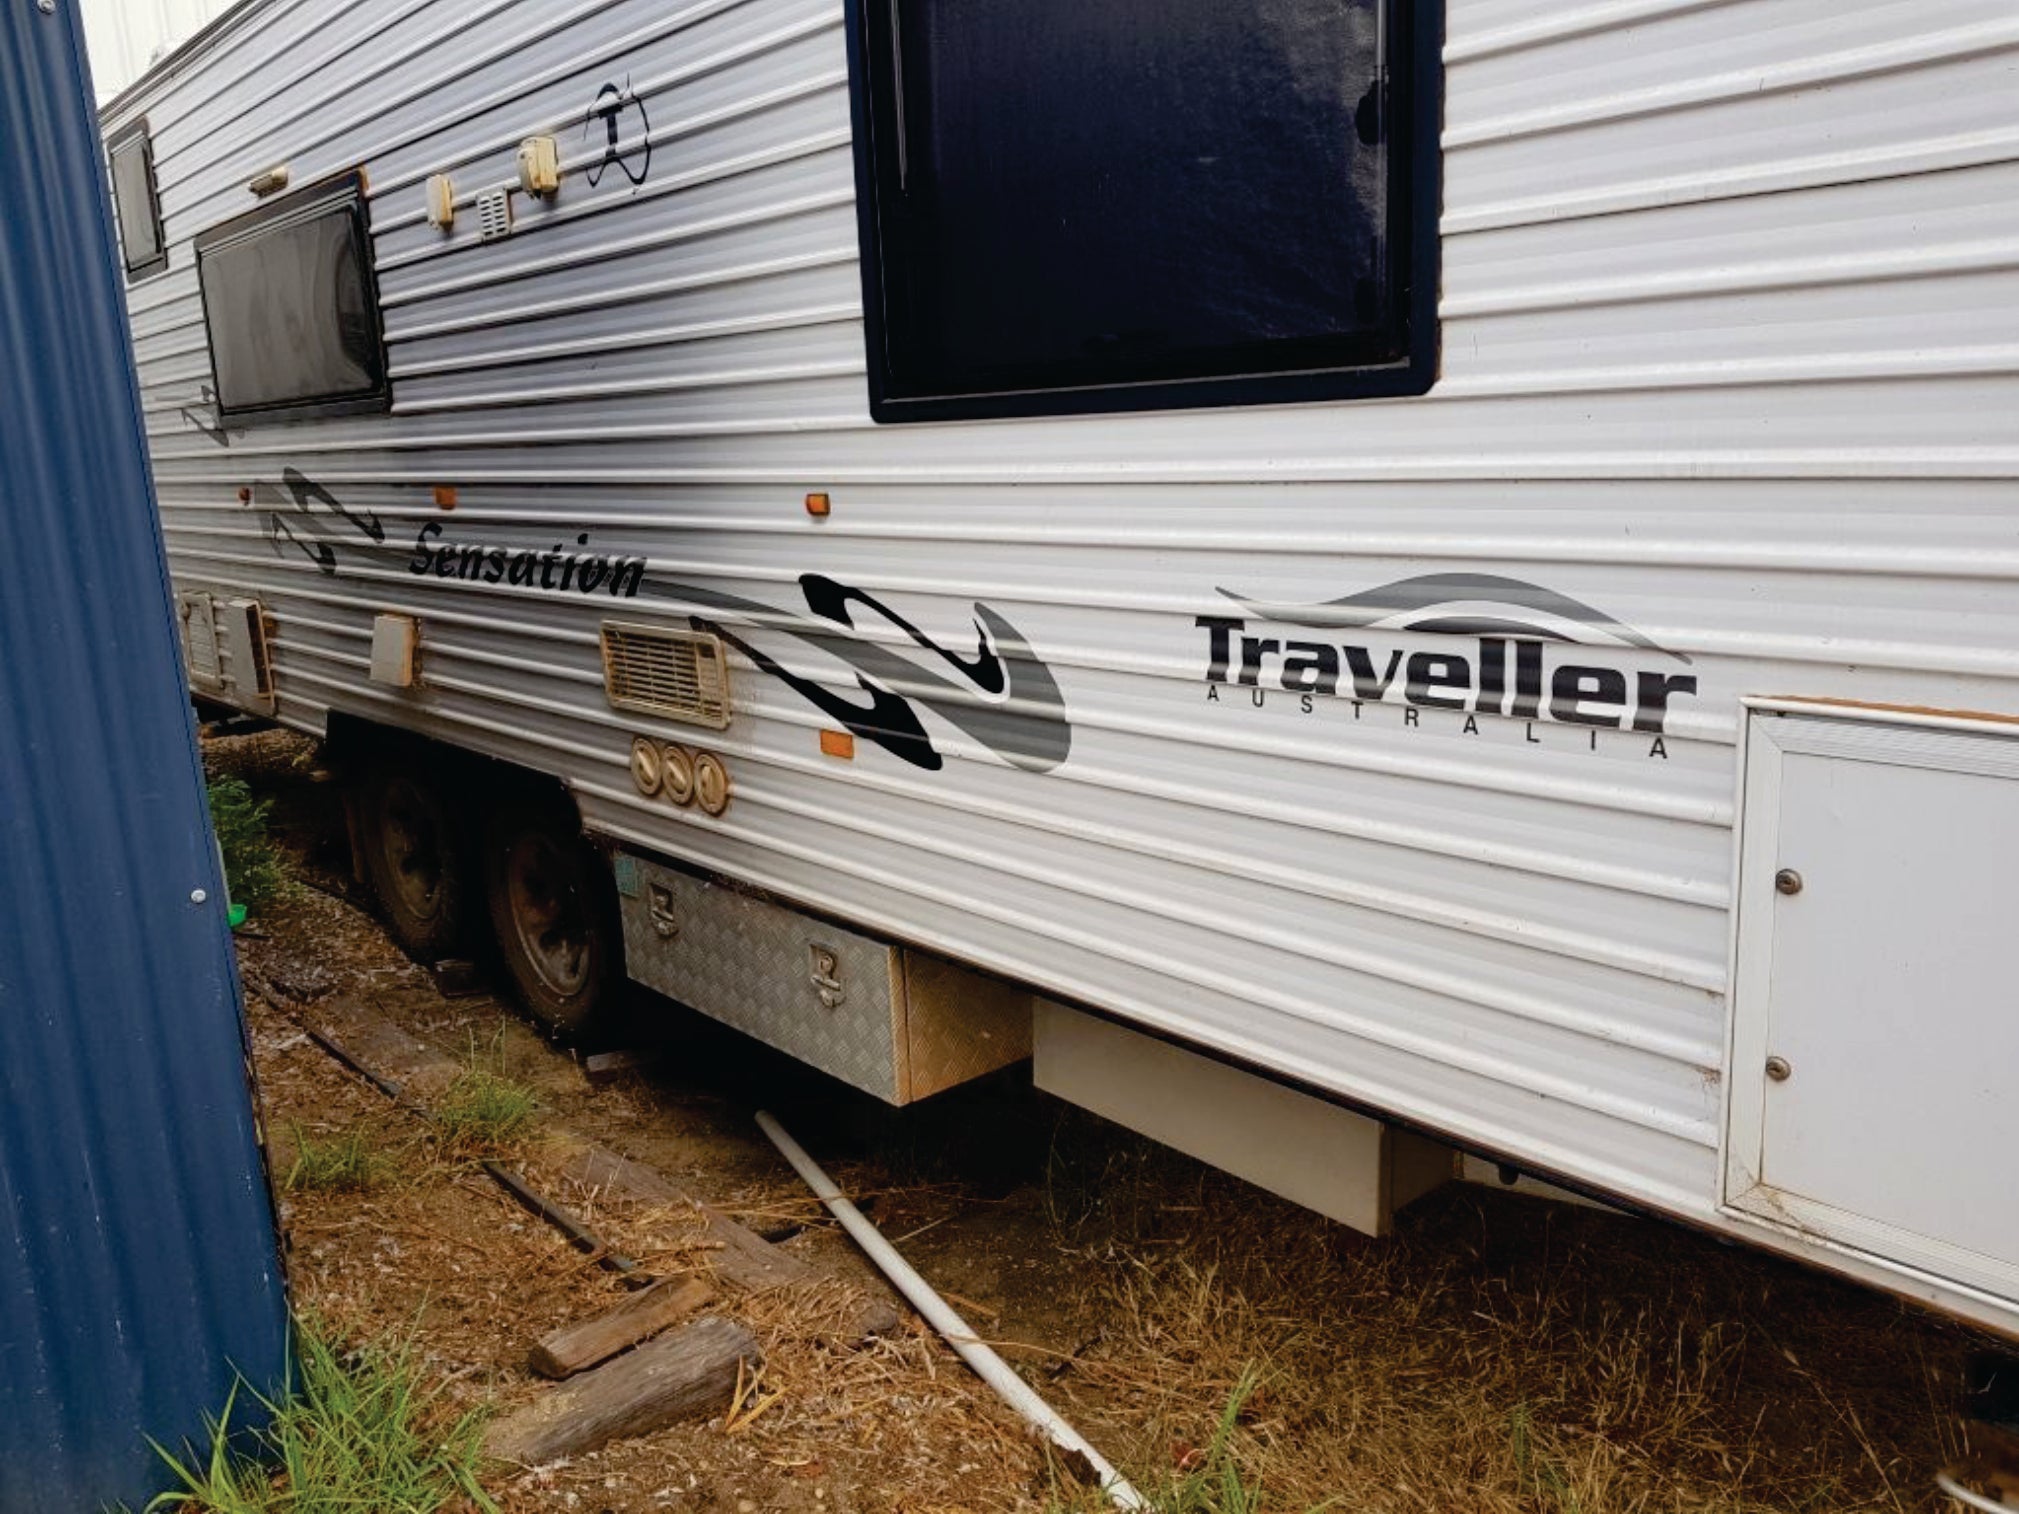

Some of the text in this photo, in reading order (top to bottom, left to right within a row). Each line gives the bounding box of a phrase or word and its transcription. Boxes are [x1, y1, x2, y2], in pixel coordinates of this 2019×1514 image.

[408, 522, 648, 597] Sensation
[1195, 616, 1697, 733] Traveller
[1206, 684, 1668, 759] AUSTRALIA
